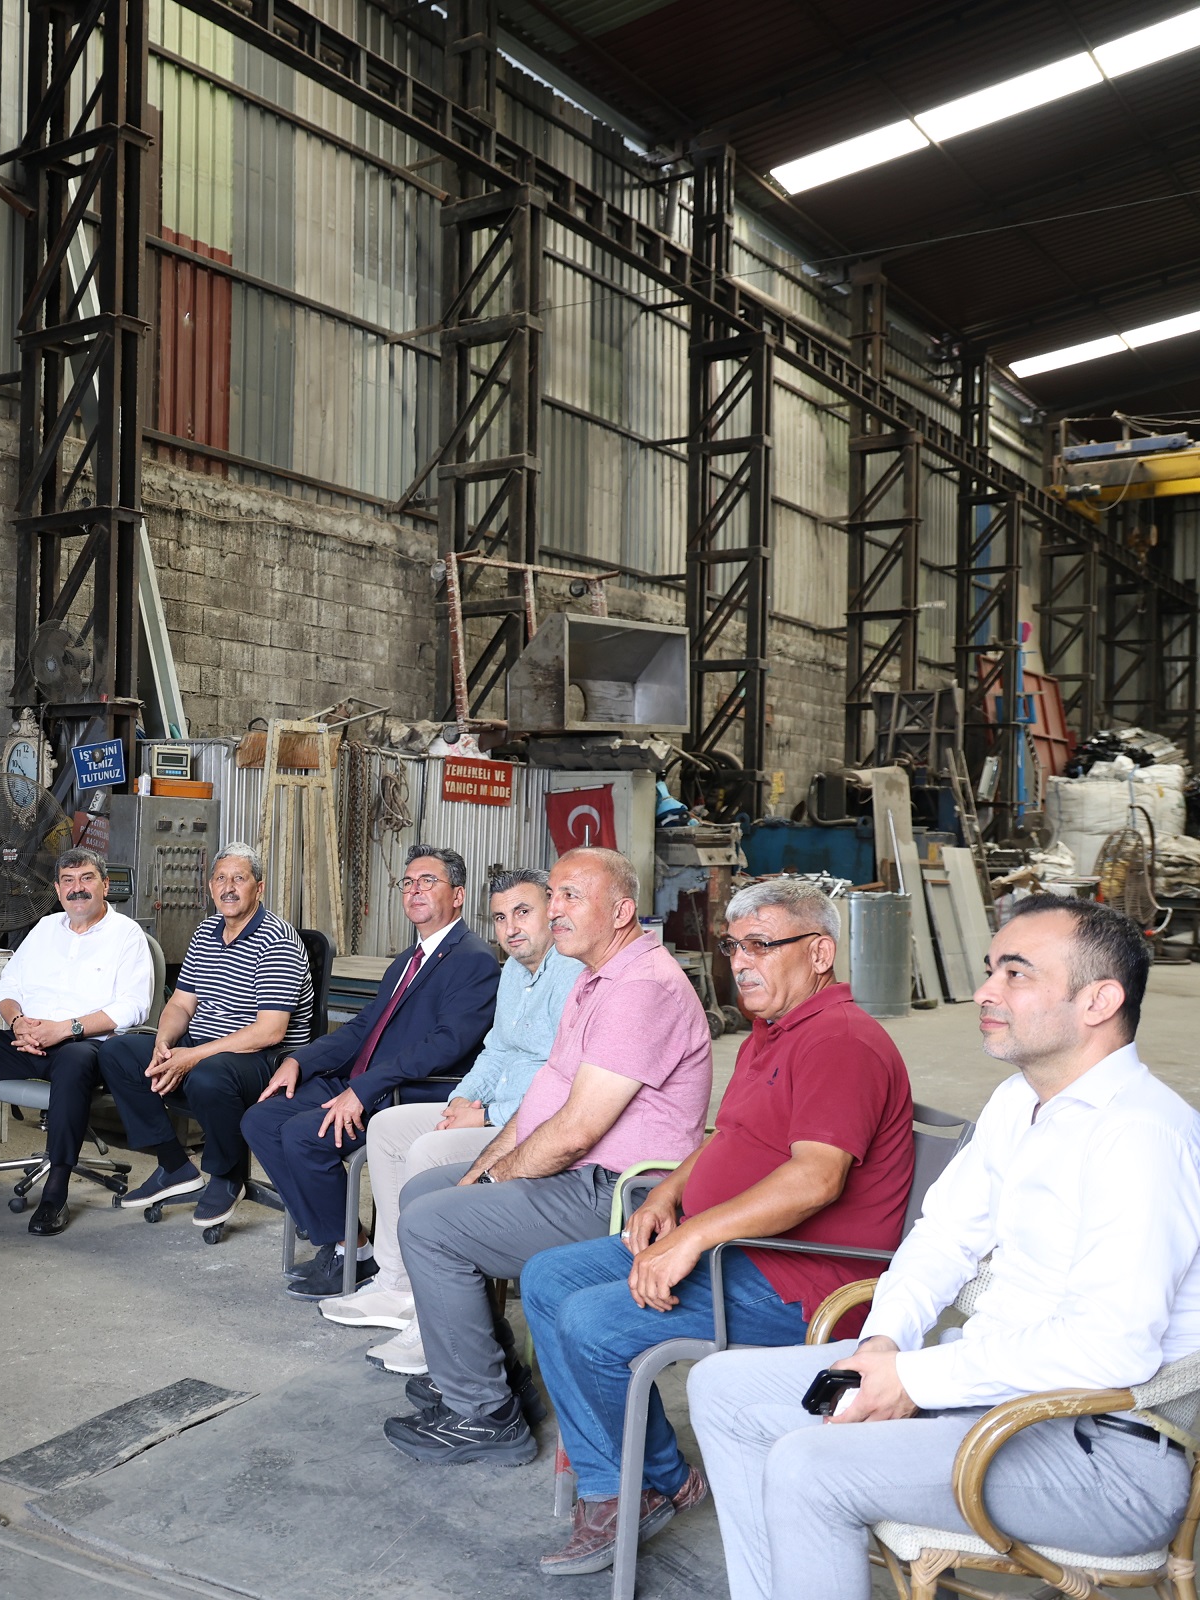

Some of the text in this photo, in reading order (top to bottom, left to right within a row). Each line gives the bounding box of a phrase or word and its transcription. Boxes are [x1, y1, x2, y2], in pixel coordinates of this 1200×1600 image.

[16, 749, 22, 757] 11
[23, 745, 29, 753] 12
[12, 759, 18, 767] 10
[87, 757, 114, 771] TEMİZ
[81, 768, 121, 783] TUTUNUZ
[446, 764, 506, 782] TEHLİKELİ VE
[445, 781, 478, 795] YANICI
